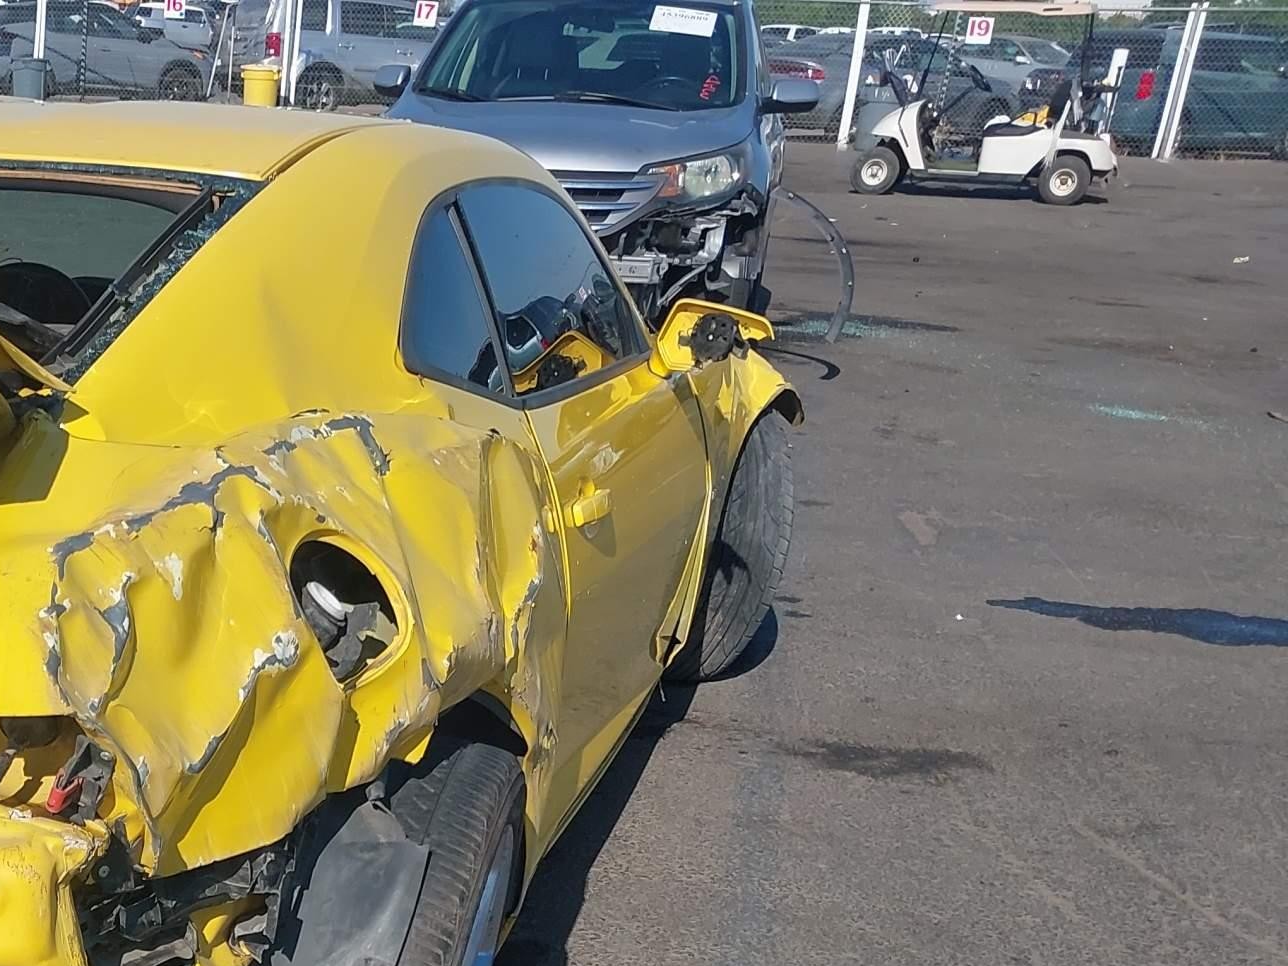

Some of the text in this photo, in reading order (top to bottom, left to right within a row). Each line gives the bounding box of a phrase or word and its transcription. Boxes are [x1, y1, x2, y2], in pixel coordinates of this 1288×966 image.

[167, 0, 183, 11] 16
[416, 3, 436, 19] 17
[969, 20, 991, 36] 19
